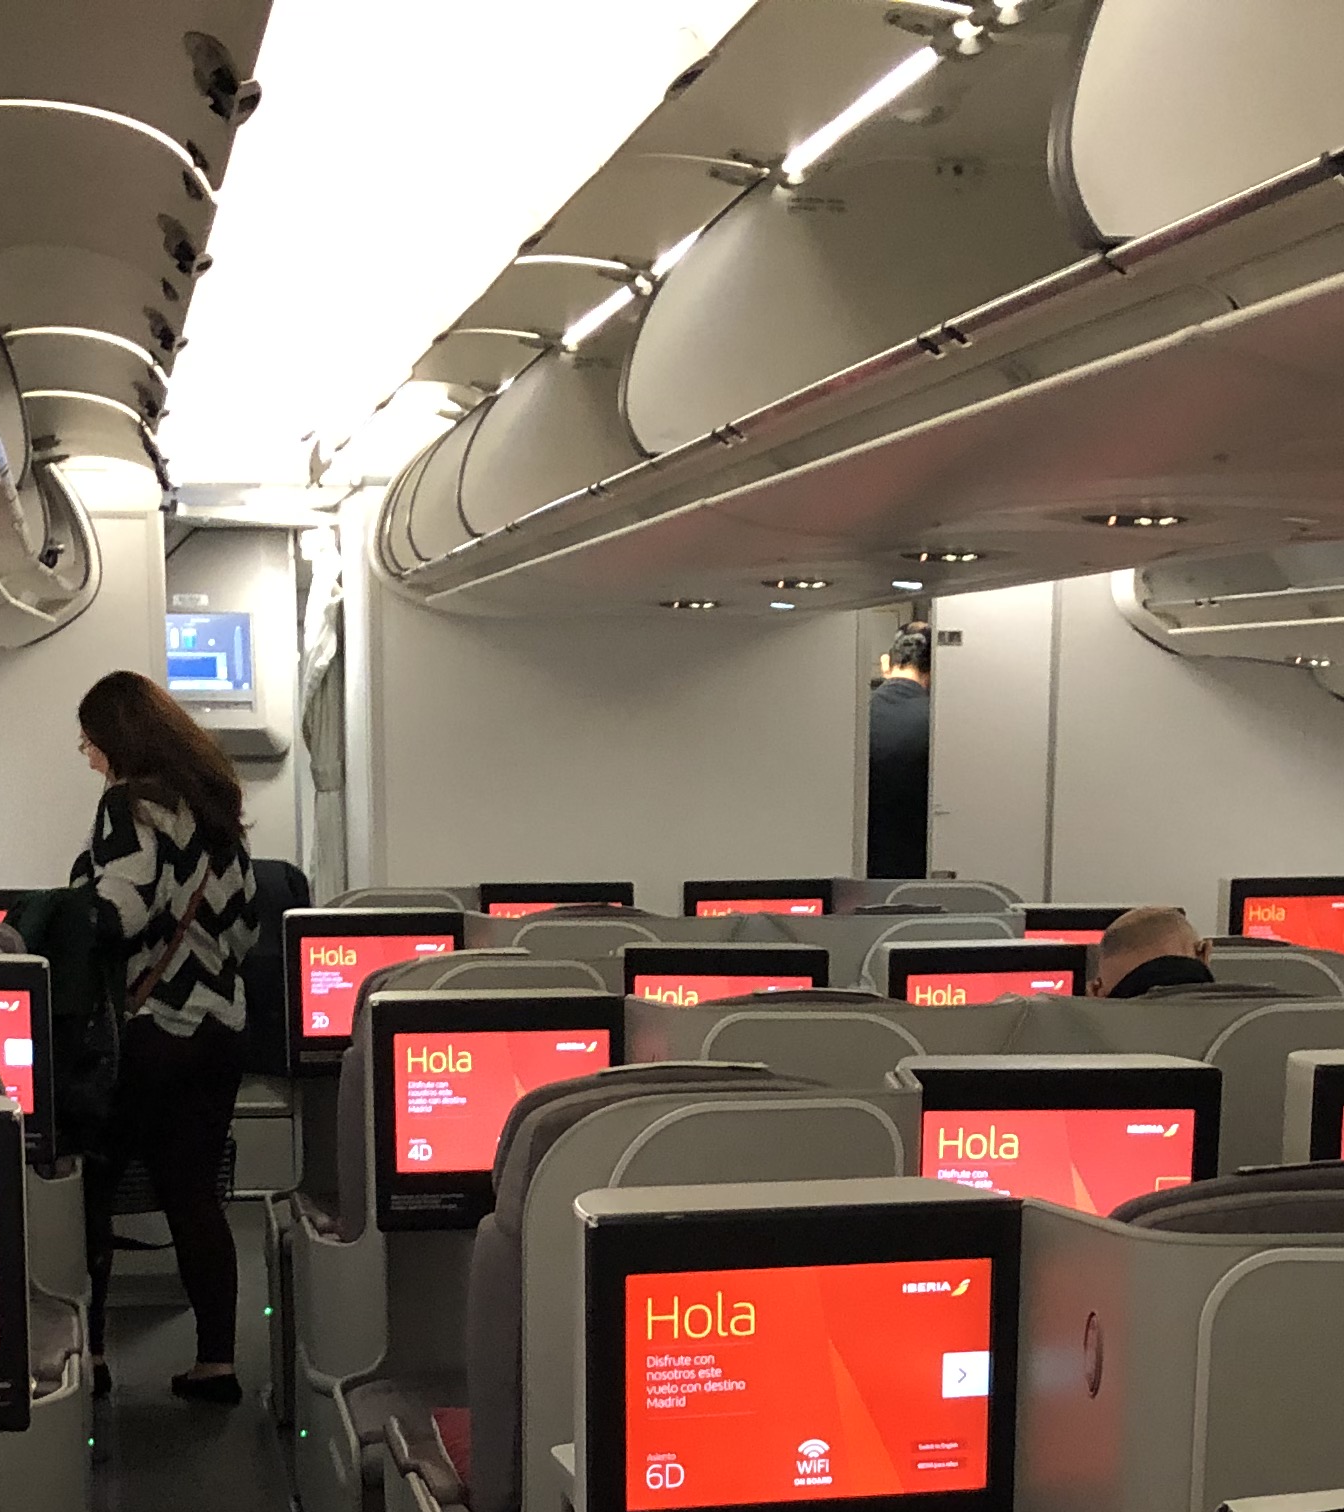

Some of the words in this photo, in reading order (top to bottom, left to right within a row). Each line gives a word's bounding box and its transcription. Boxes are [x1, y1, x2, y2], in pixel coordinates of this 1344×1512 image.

[1248, 904, 1285, 921] Hola
[310, 945, 356, 966] Hola
[914, 984, 966, 1005] Hola
[407, 1045, 472, 1073] Hola
[939, 1125, 1019, 1159] Hola
[407, 1144, 432, 1161] 4D
[902, 1280, 951, 1294] IBERIA
[648, 1291, 755, 1340] Hola
[646, 1354, 692, 1368] Disfrute
[693, 1354, 715, 1366] con
[646, 1368, 696, 1381] nosotros
[698, 1367, 722, 1379] este
[646, 1382, 678, 1395] vuelo
[680, 1382, 702, 1394] con
[703, 1379, 746, 1392] destino
[646, 1395, 687, 1409] Madrid
[796, 1459, 830, 1475] WiFi
[646, 1464, 684, 1489] 6D
